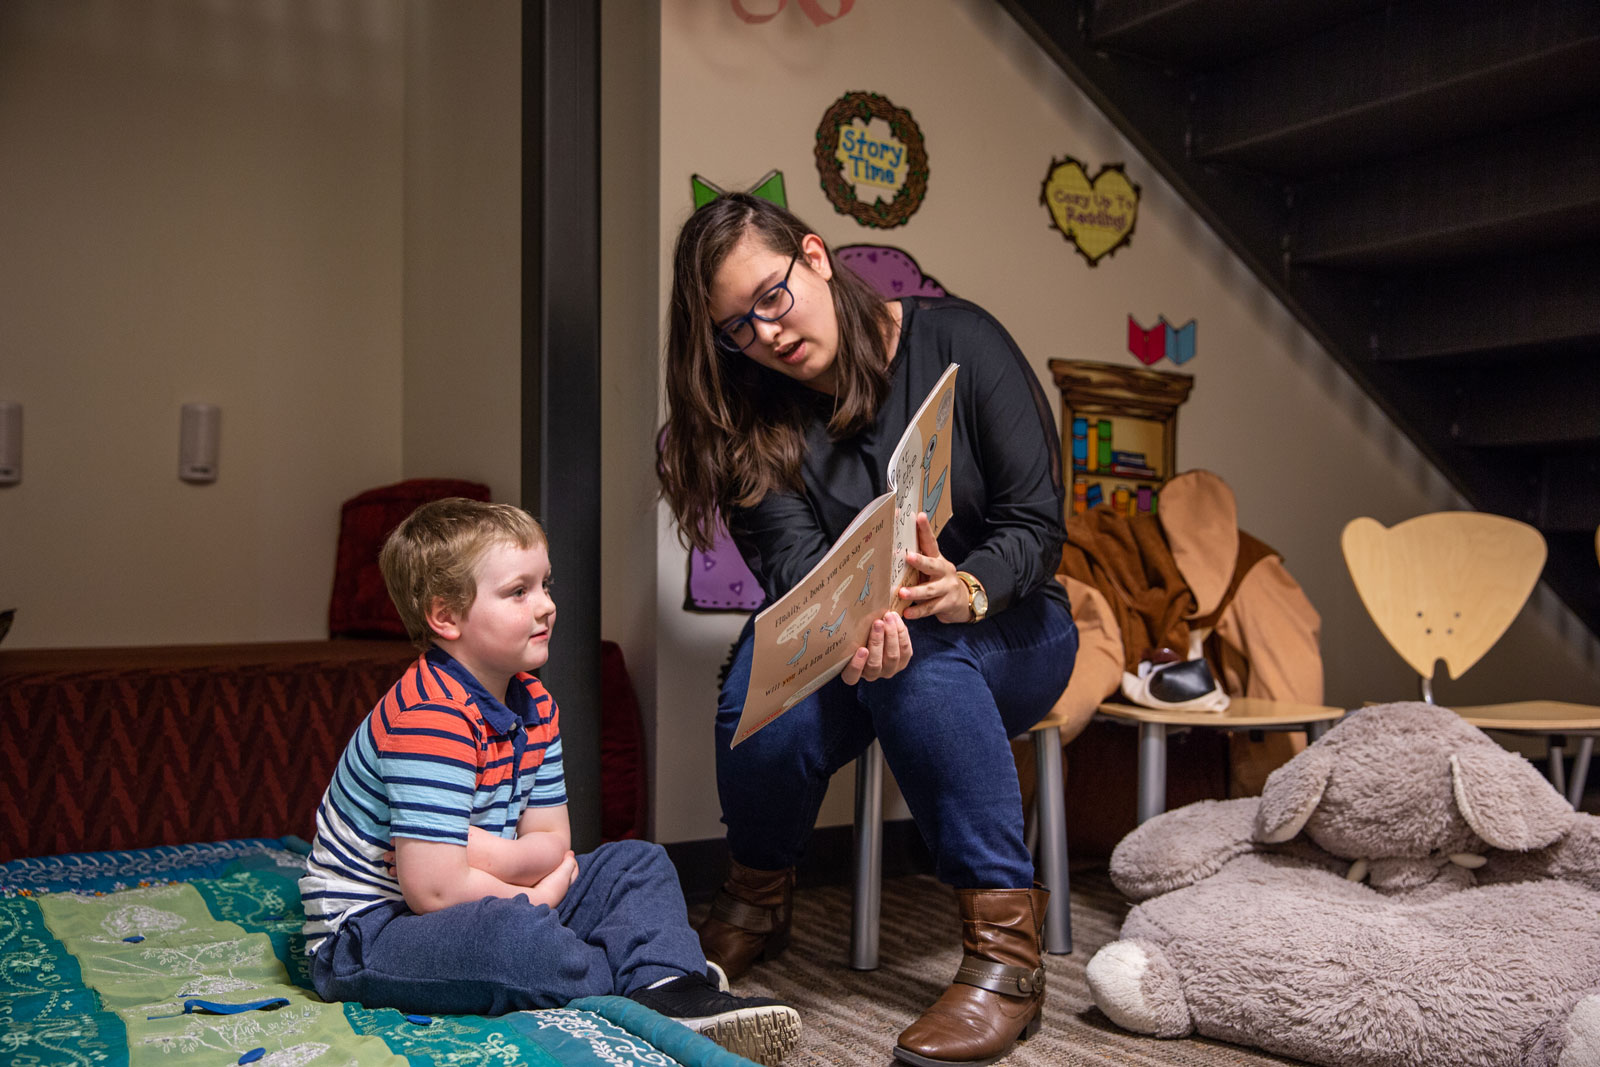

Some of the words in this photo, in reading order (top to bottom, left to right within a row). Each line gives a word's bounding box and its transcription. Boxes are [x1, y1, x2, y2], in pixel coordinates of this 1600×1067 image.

[842, 129, 903, 168] Story
[848, 154, 895, 184] Time
[1054, 188, 1090, 210] Cozy
[1093, 193, 1112, 210] Up
[1116, 194, 1133, 210] To
[774, 603, 801, 628] Finally,
[810, 579, 826, 599] book
[826, 567, 838, 584] you
[838, 555, 851, 570] can
[851, 542, 862, 558] say
[782, 672, 796, 687] you
[809, 653, 823, 667] him
[824, 631, 847, 656] drive?
